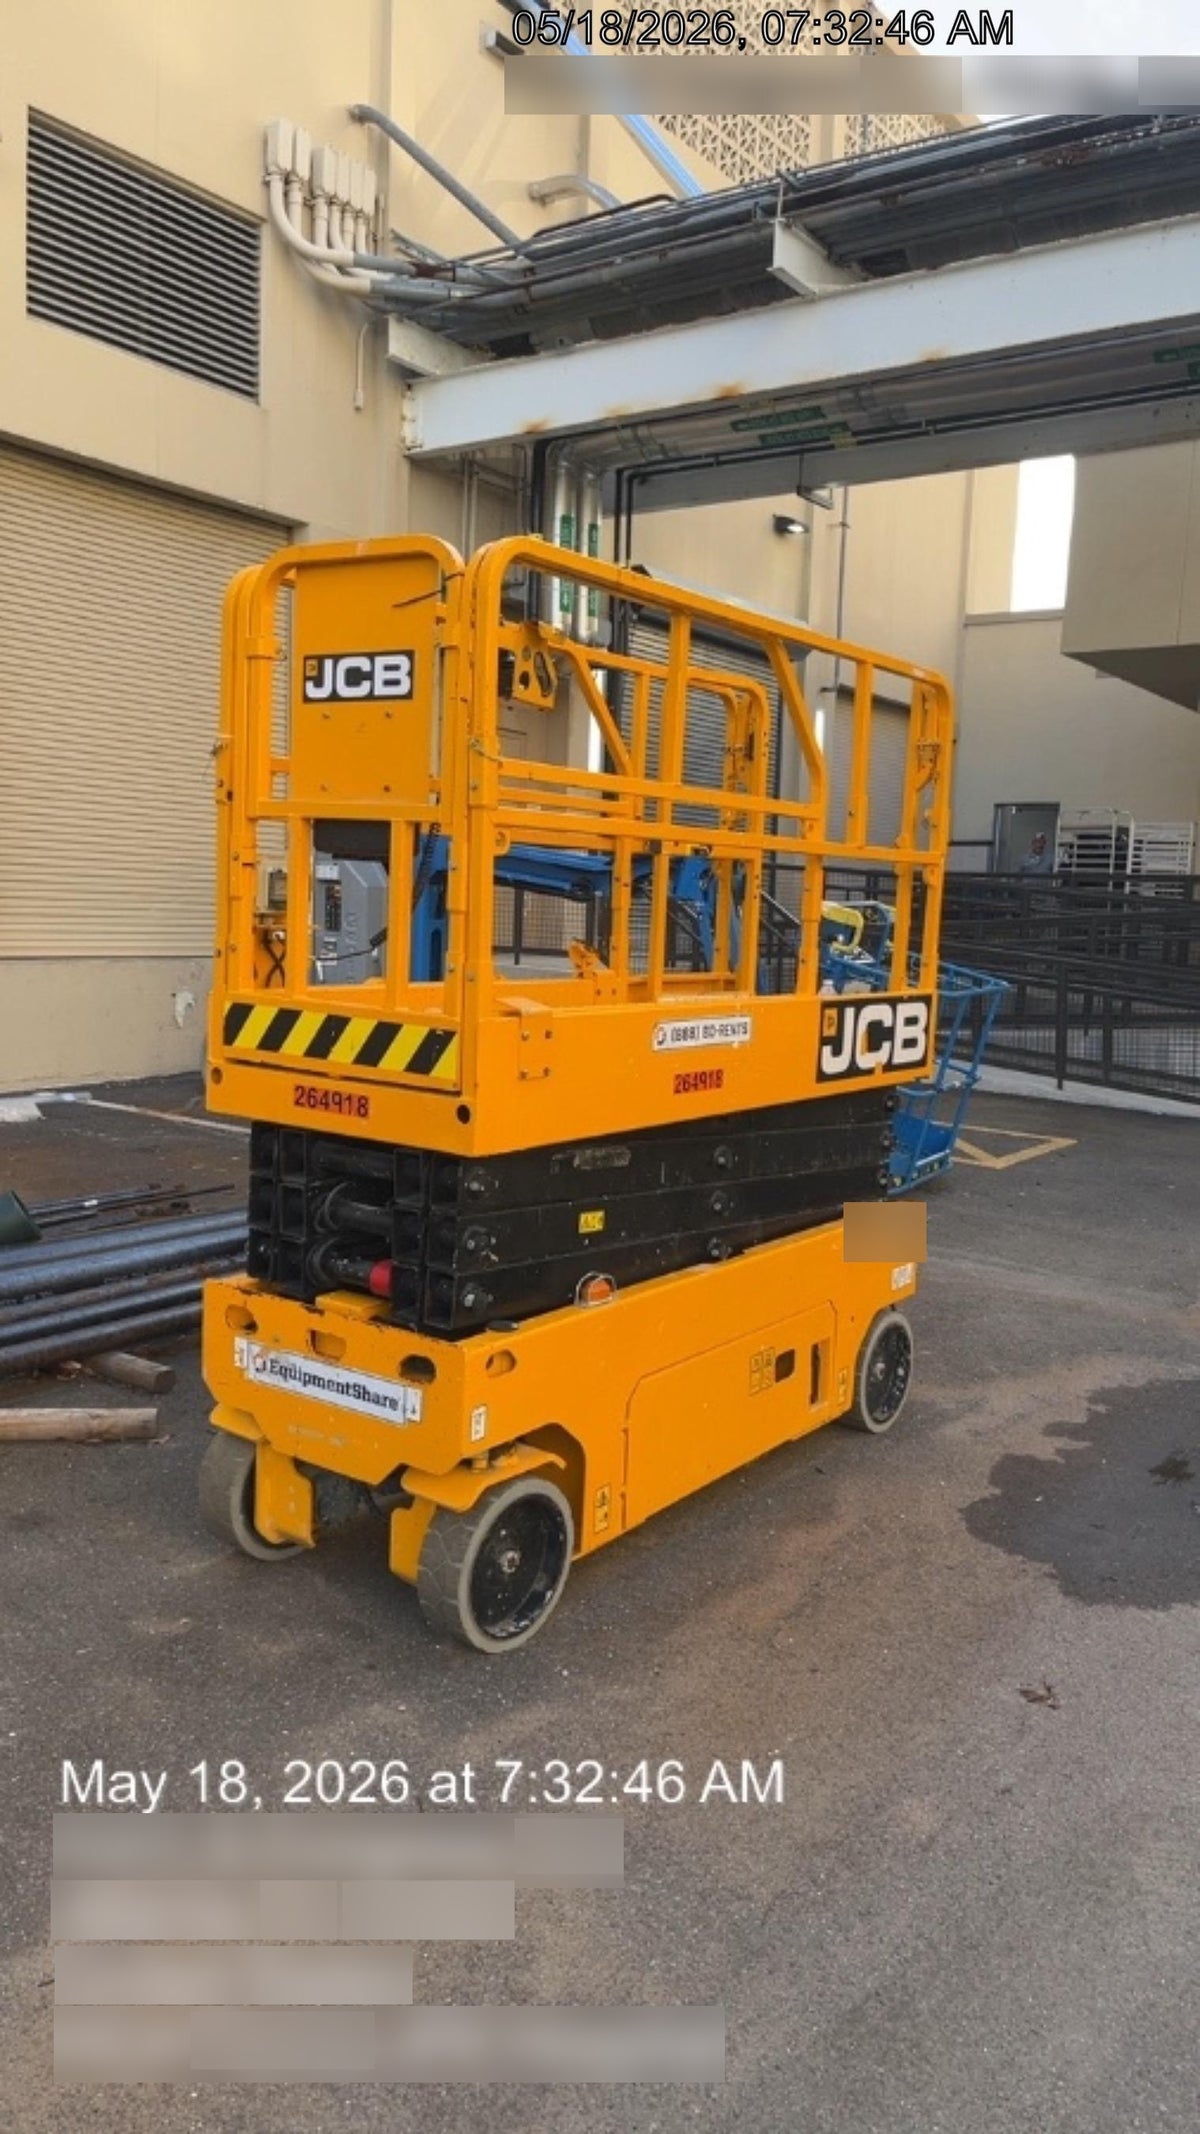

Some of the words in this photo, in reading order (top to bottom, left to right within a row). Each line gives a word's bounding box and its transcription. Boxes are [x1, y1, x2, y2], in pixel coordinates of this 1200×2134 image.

[305, 654, 412, 699] JCB
[821, 1001, 928, 1075] JCB
[295, 1085, 369, 1118] 264918
[674, 1069, 724, 1095] 264918
[269, 1358, 399, 1412] EquipmentShare
